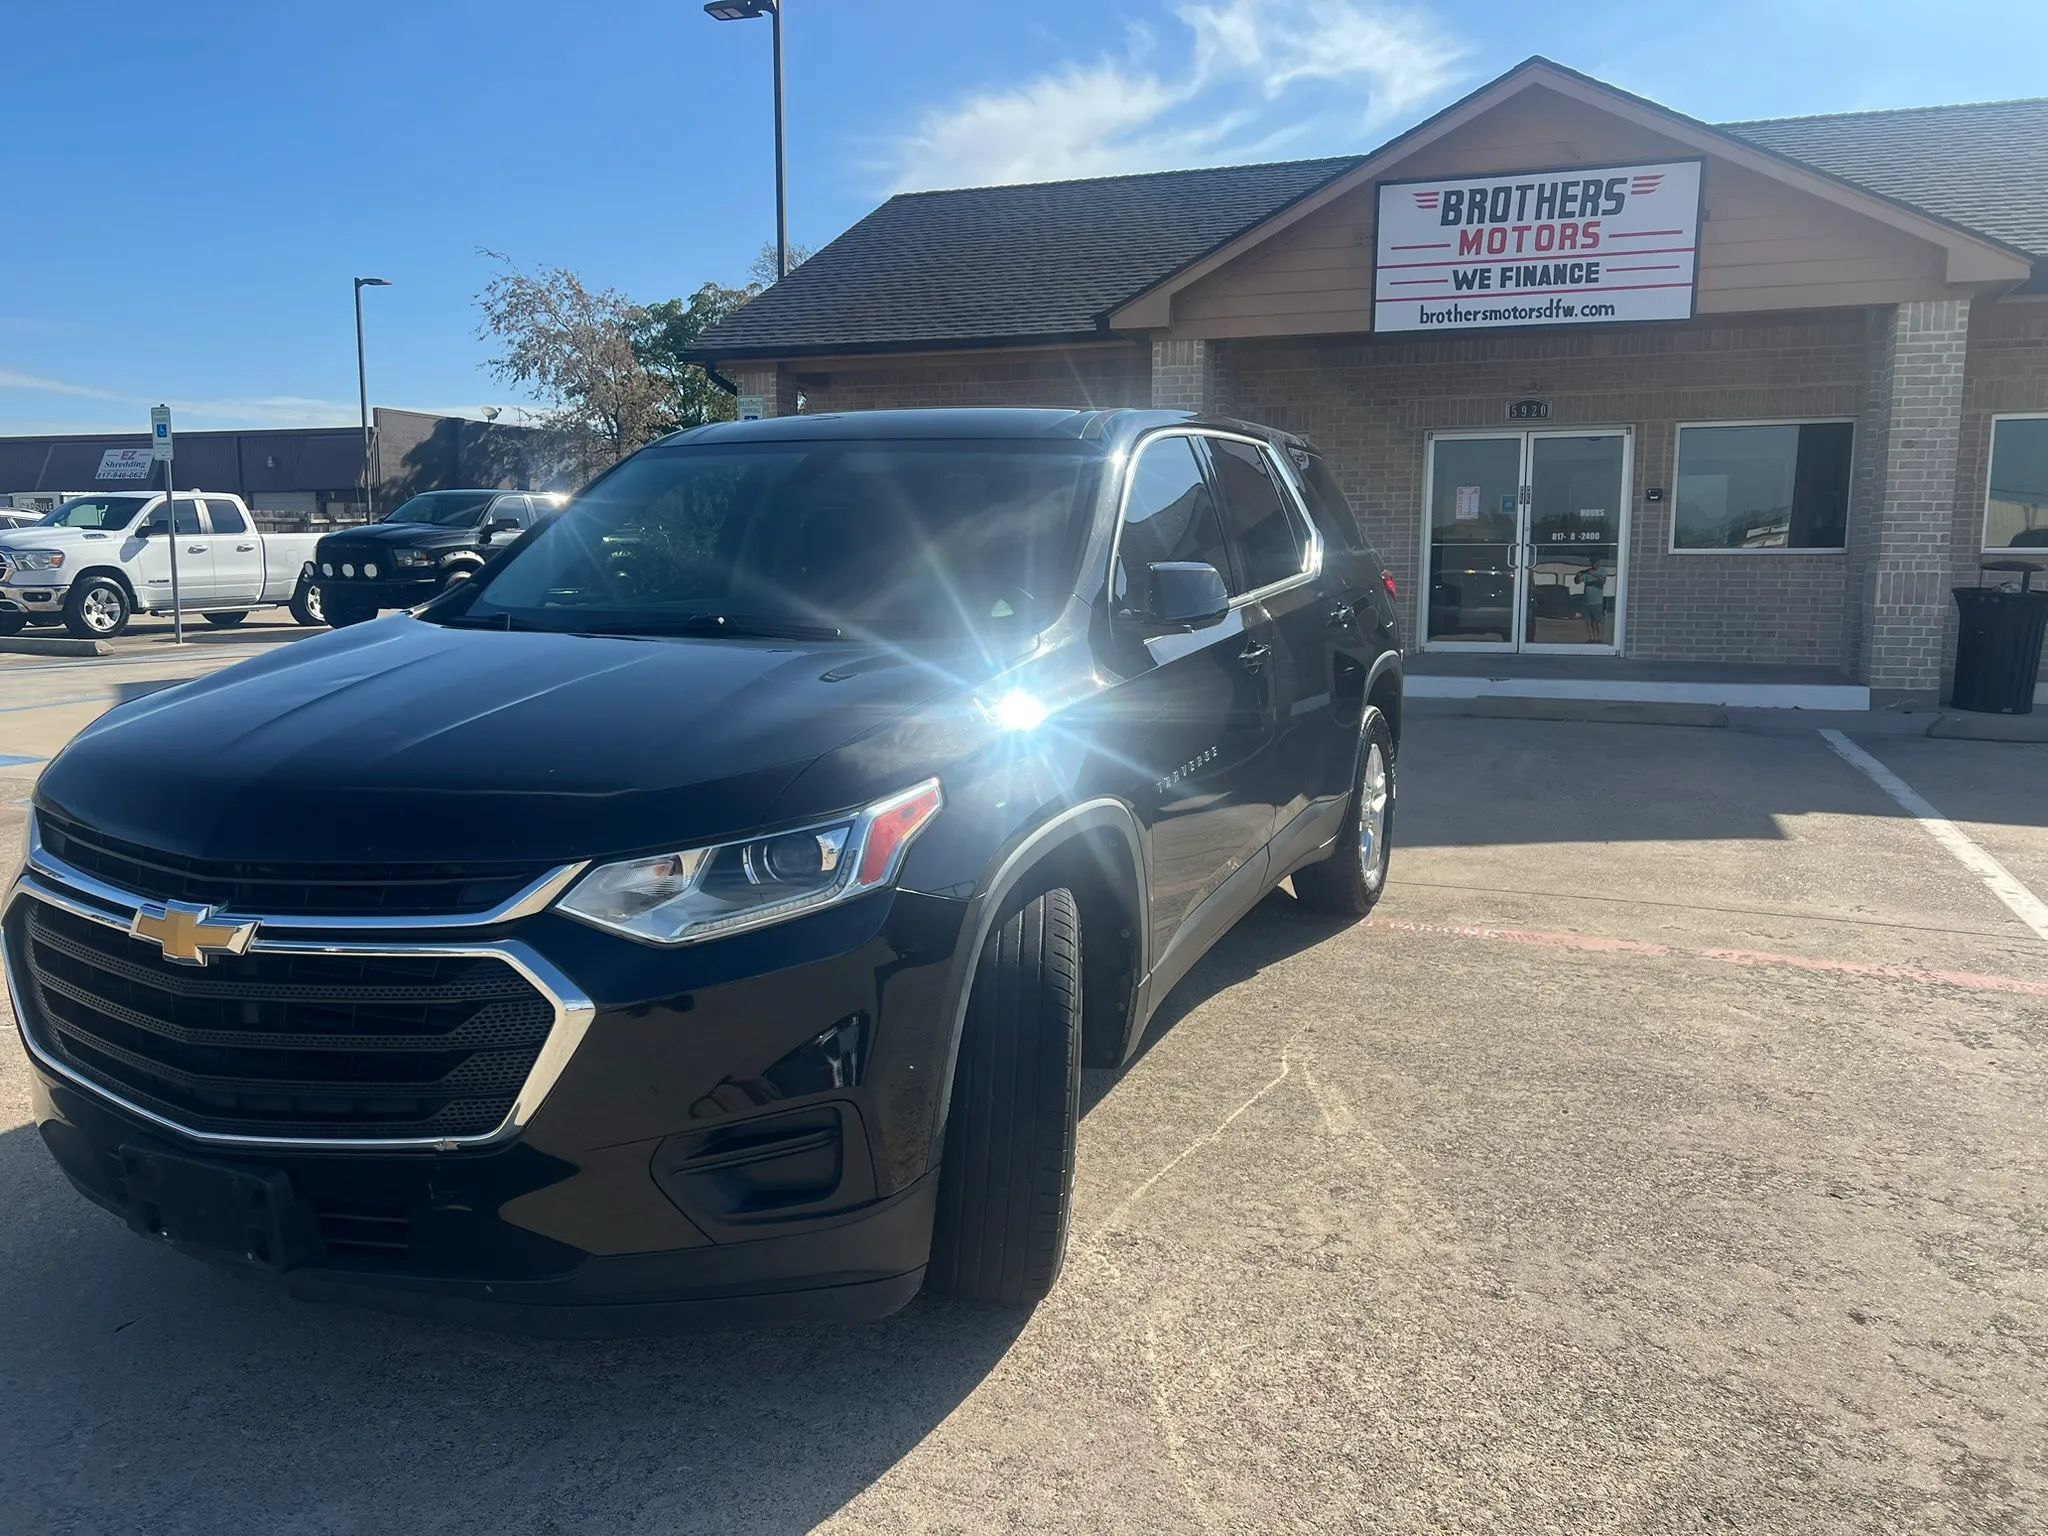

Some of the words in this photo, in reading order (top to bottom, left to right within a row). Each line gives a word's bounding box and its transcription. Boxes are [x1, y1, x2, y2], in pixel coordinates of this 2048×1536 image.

[1440, 177, 1628, 226] BROTHERS
[1458, 220, 1602, 256] MOTORS
[1452, 268, 1492, 291] WE
[1499, 262, 1600, 289] FINANCE
[1419, 298, 1615, 324] brothersmotorsdfw.com
[1511, 404, 1546, 417] 5920
[104, 460, 147, 468] Shredding
[121, 450, 137, 460] EZ
[1156, 746, 1217, 794] TRAVERSE
